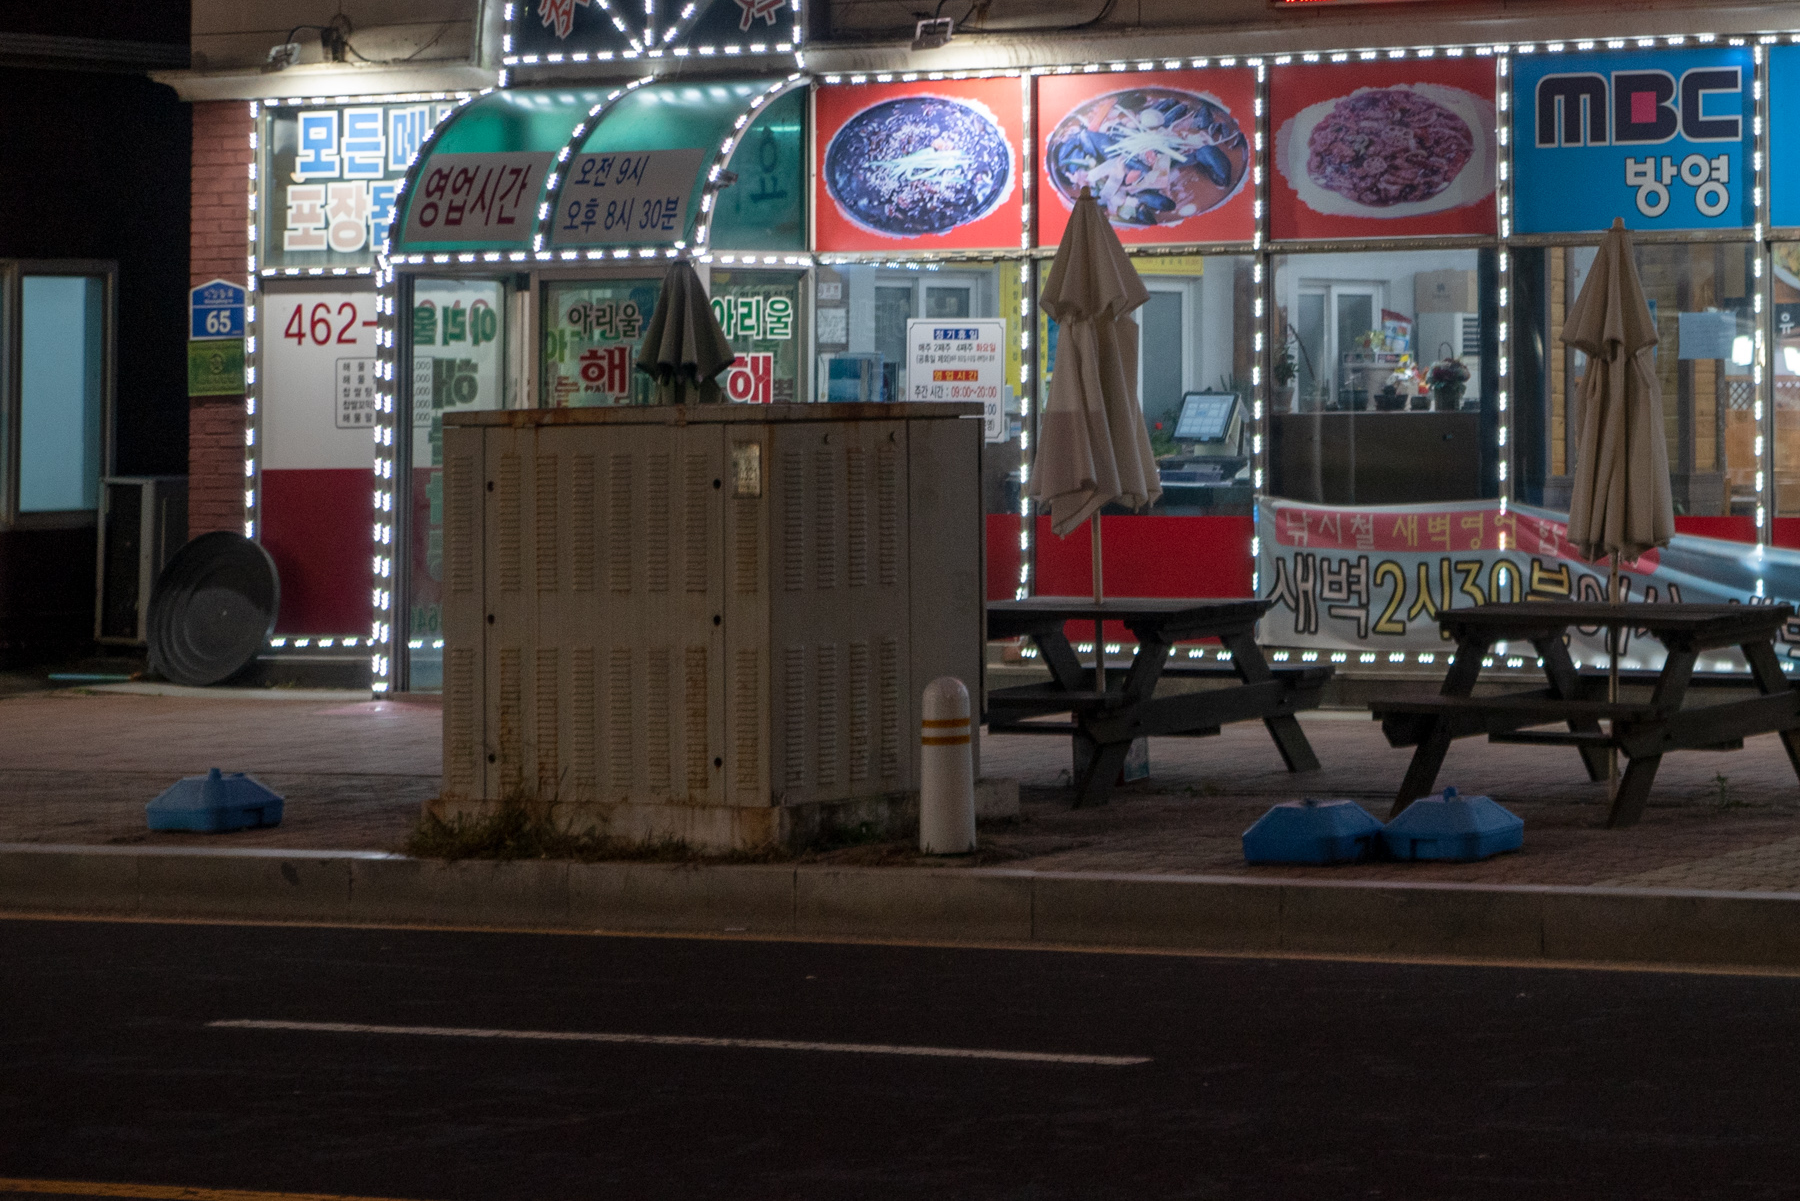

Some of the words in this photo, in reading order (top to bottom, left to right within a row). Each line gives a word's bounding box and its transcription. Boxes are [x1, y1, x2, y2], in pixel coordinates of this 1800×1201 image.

[1535, 66, 1743, 149] MBC
[296, 105, 452, 180] 모든메
[574, 156, 614, 187] 오전
[616, 155, 651, 186] 9시
[1624, 153, 1730, 218] 방영
[418, 163, 533, 229] 영업시간
[562, 198, 599, 234] 오후
[603, 200, 637, 232] 8시
[638, 196, 680, 232] 30분
[206, 309, 232, 334] 65
[284, 302, 379, 346] 462-
[567, 303, 641, 339] 아리울
[711, 296, 793, 339] 아리울
[1284, 511, 1375, 550] 낚시철
